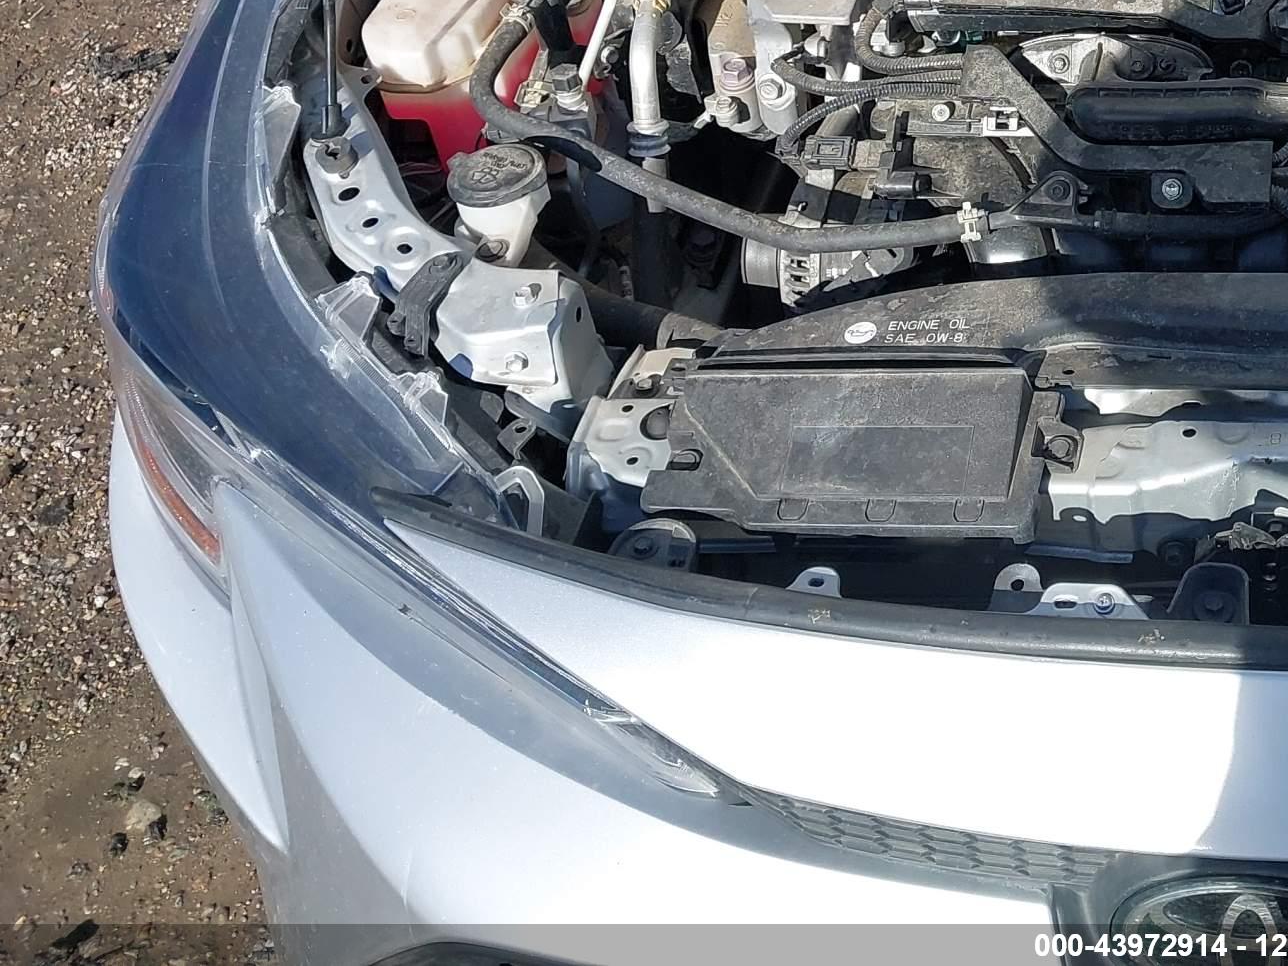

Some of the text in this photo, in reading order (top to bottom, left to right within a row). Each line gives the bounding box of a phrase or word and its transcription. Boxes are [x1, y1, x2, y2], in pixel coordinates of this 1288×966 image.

[887, 317, 970, 331] ENGINE OIL
[884, 333, 916, 343] SAE
